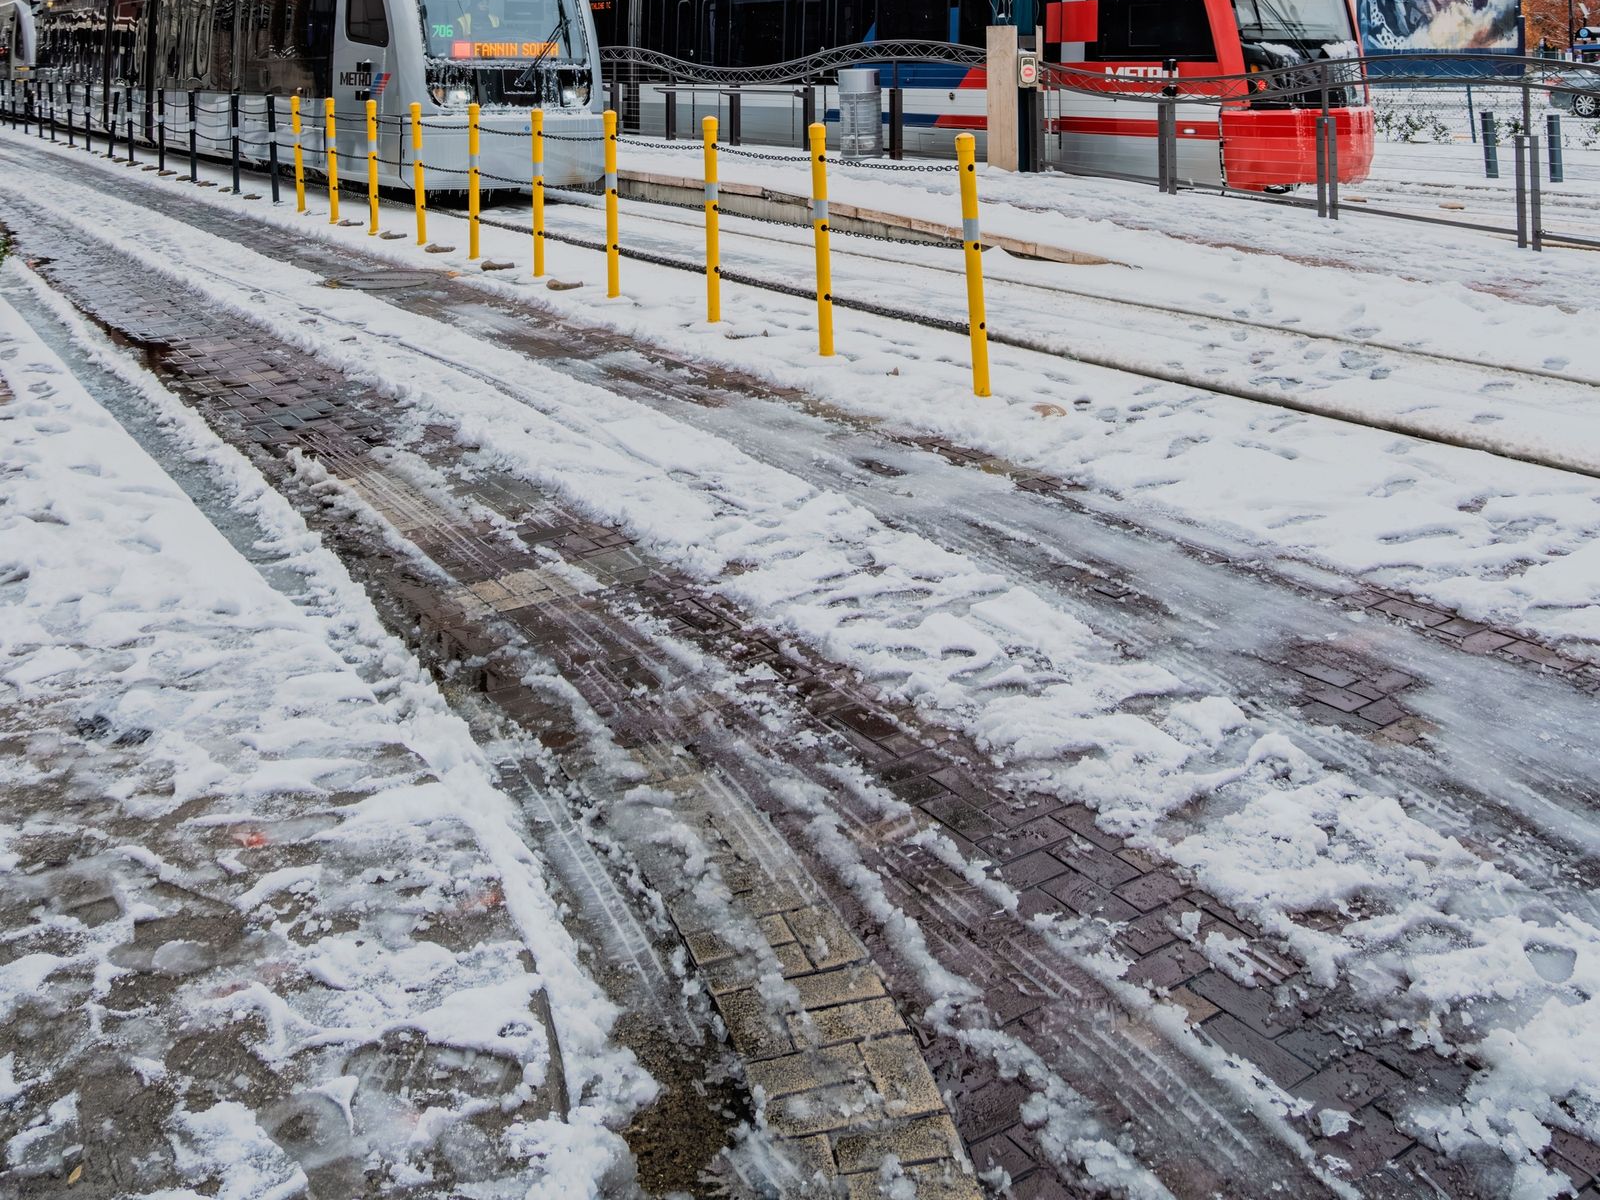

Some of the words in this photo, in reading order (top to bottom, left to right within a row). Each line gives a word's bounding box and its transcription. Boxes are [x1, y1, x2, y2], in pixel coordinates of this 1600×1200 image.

[431, 24, 454, 38] 706
[474, 42, 518, 57] FANNIN
[340, 72, 371, 86] METRO
[1105, 66, 1179, 83] METRO
